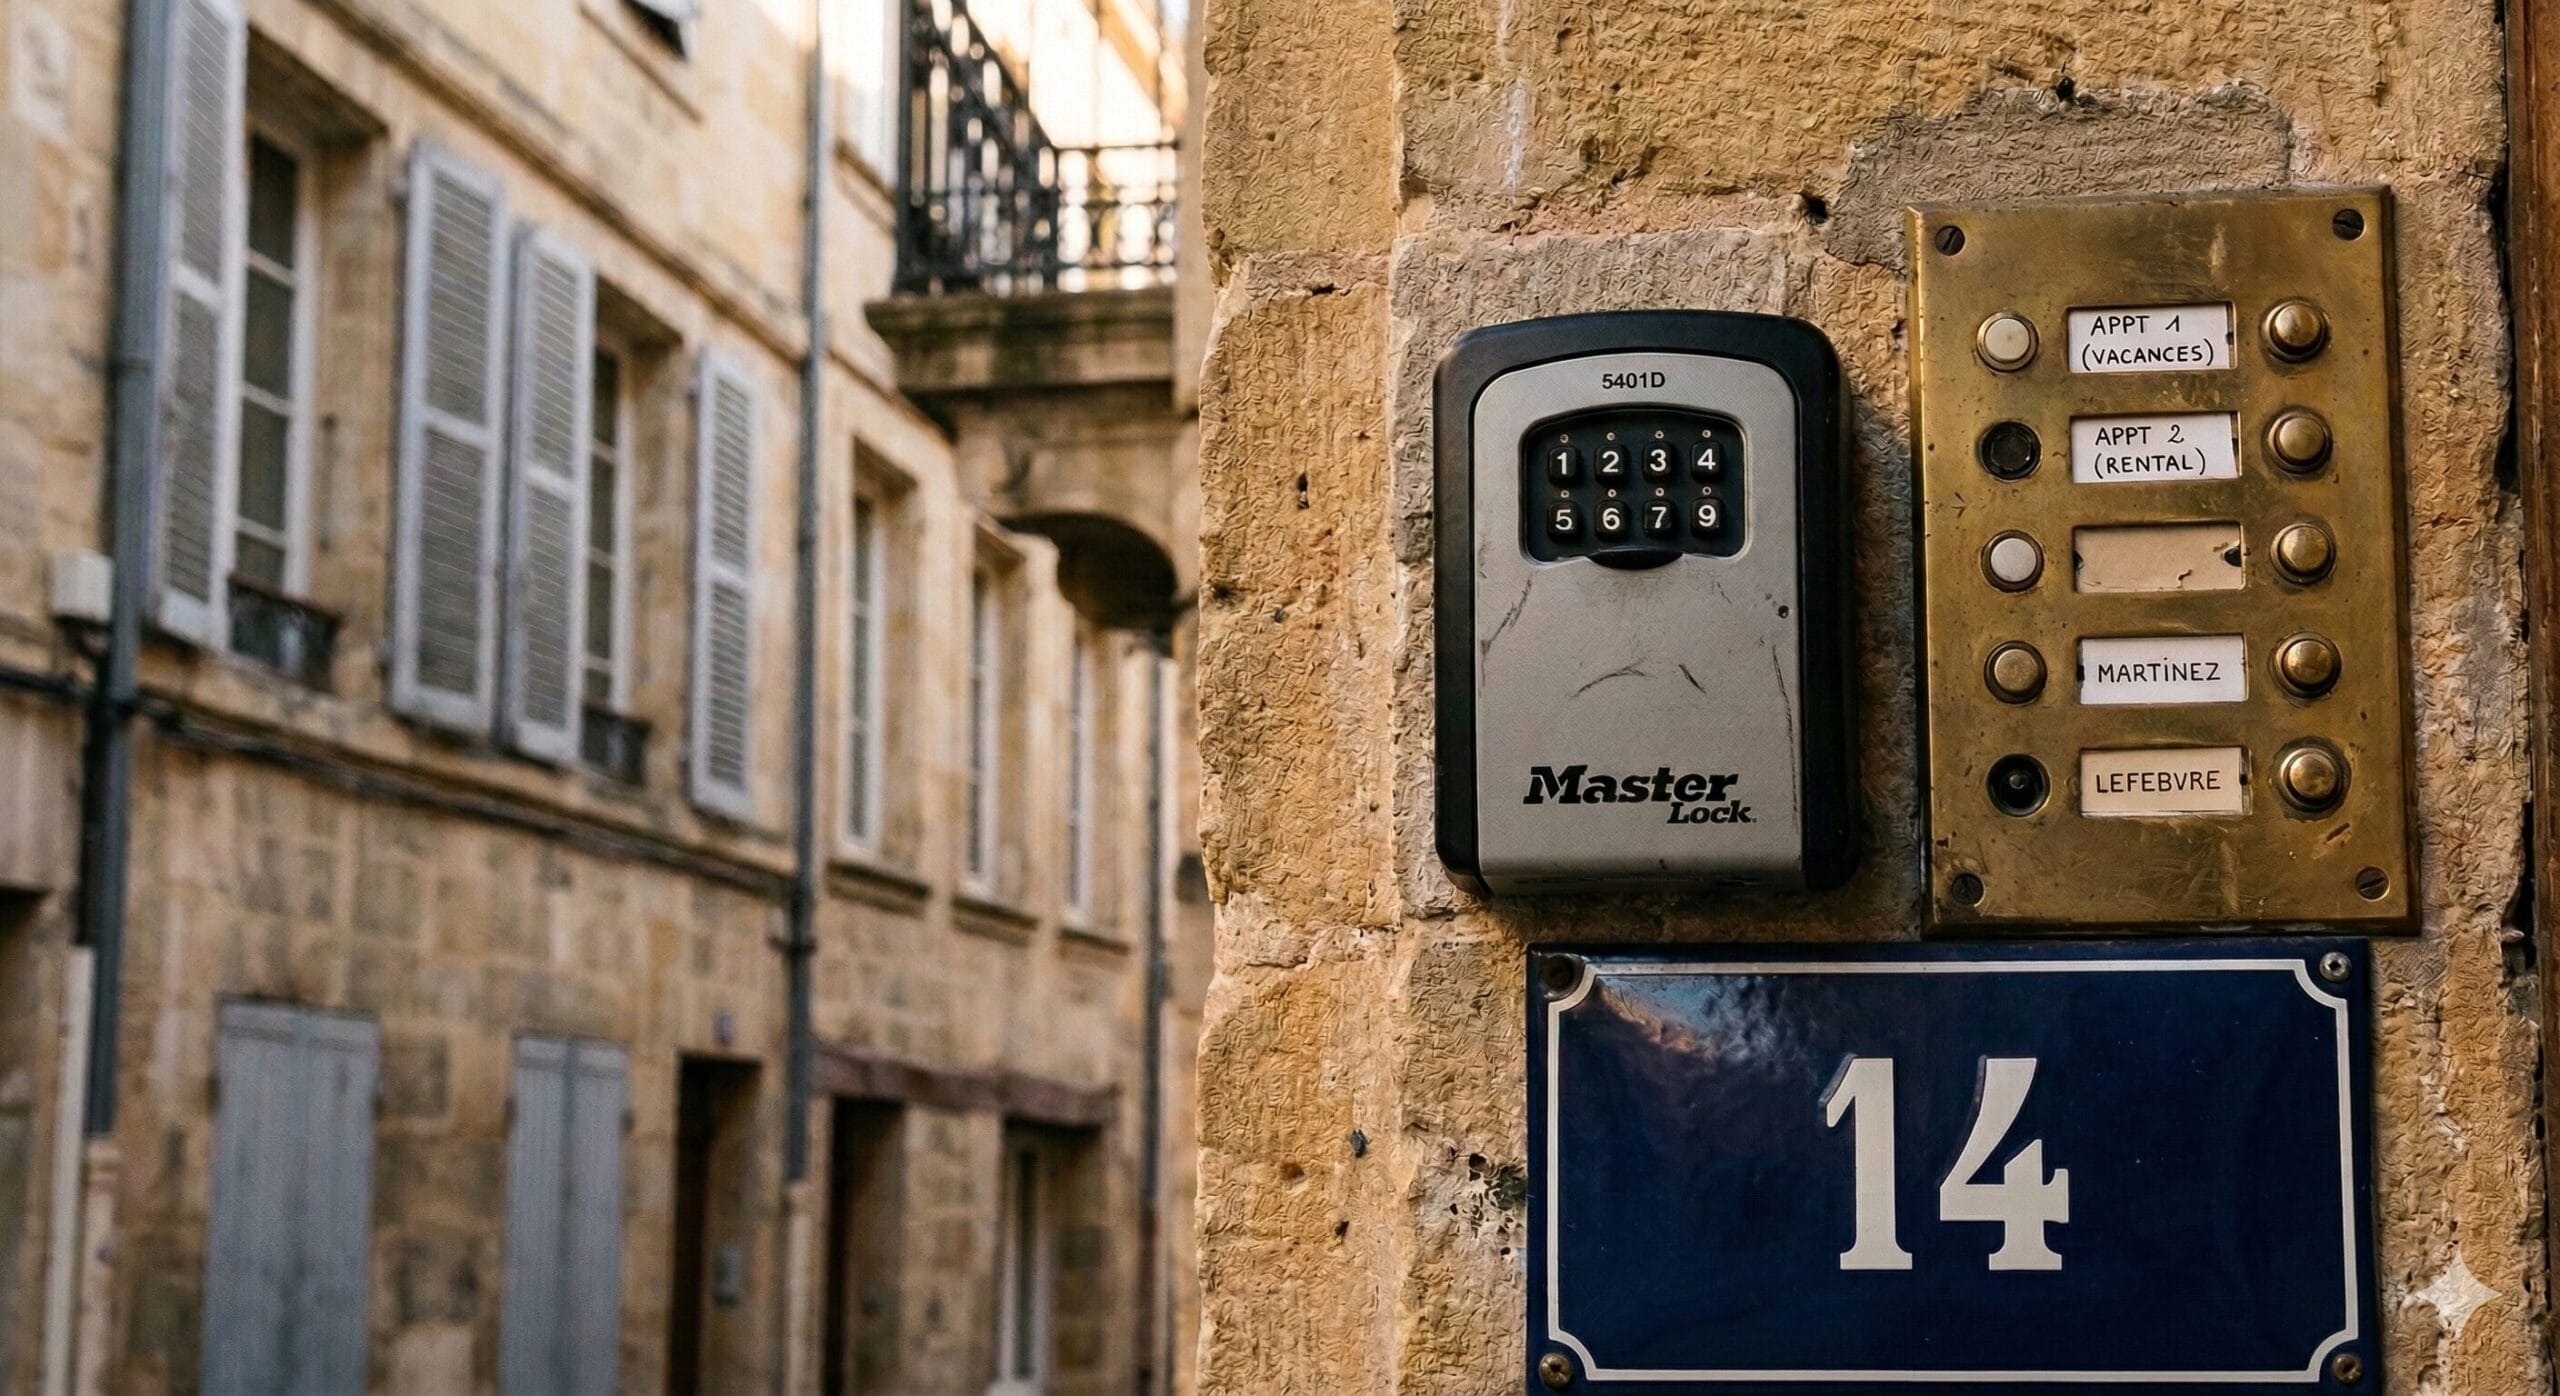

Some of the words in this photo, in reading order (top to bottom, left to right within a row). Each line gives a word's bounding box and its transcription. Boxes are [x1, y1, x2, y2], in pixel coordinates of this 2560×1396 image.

[2090, 315, 2150, 337] APPT
[2165, 314, 2180, 333] 1
[2082, 337, 2214, 372] (VACANCES)
[1601, 372, 1666, 389] 5401D
[2095, 426, 2151, 446] APPT
[2167, 424, 2185, 444] 2
[1556, 452, 1568, 475] 1
[1602, 450, 1619, 473] 2
[1650, 449, 1667, 472] 3
[1697, 448, 1716, 470] 4
[2094, 447, 2206, 480] (RENTAL)
[1555, 508, 1573, 530] 5
[1602, 507, 1620, 530] 6
[1651, 506, 1667, 529] 7
[1698, 504, 1716, 527] 9
[1523, 764, 1739, 805] Master
[2095, 770, 2221, 793] LEFEBVRE
[1825, 1057, 2069, 1271] 14
